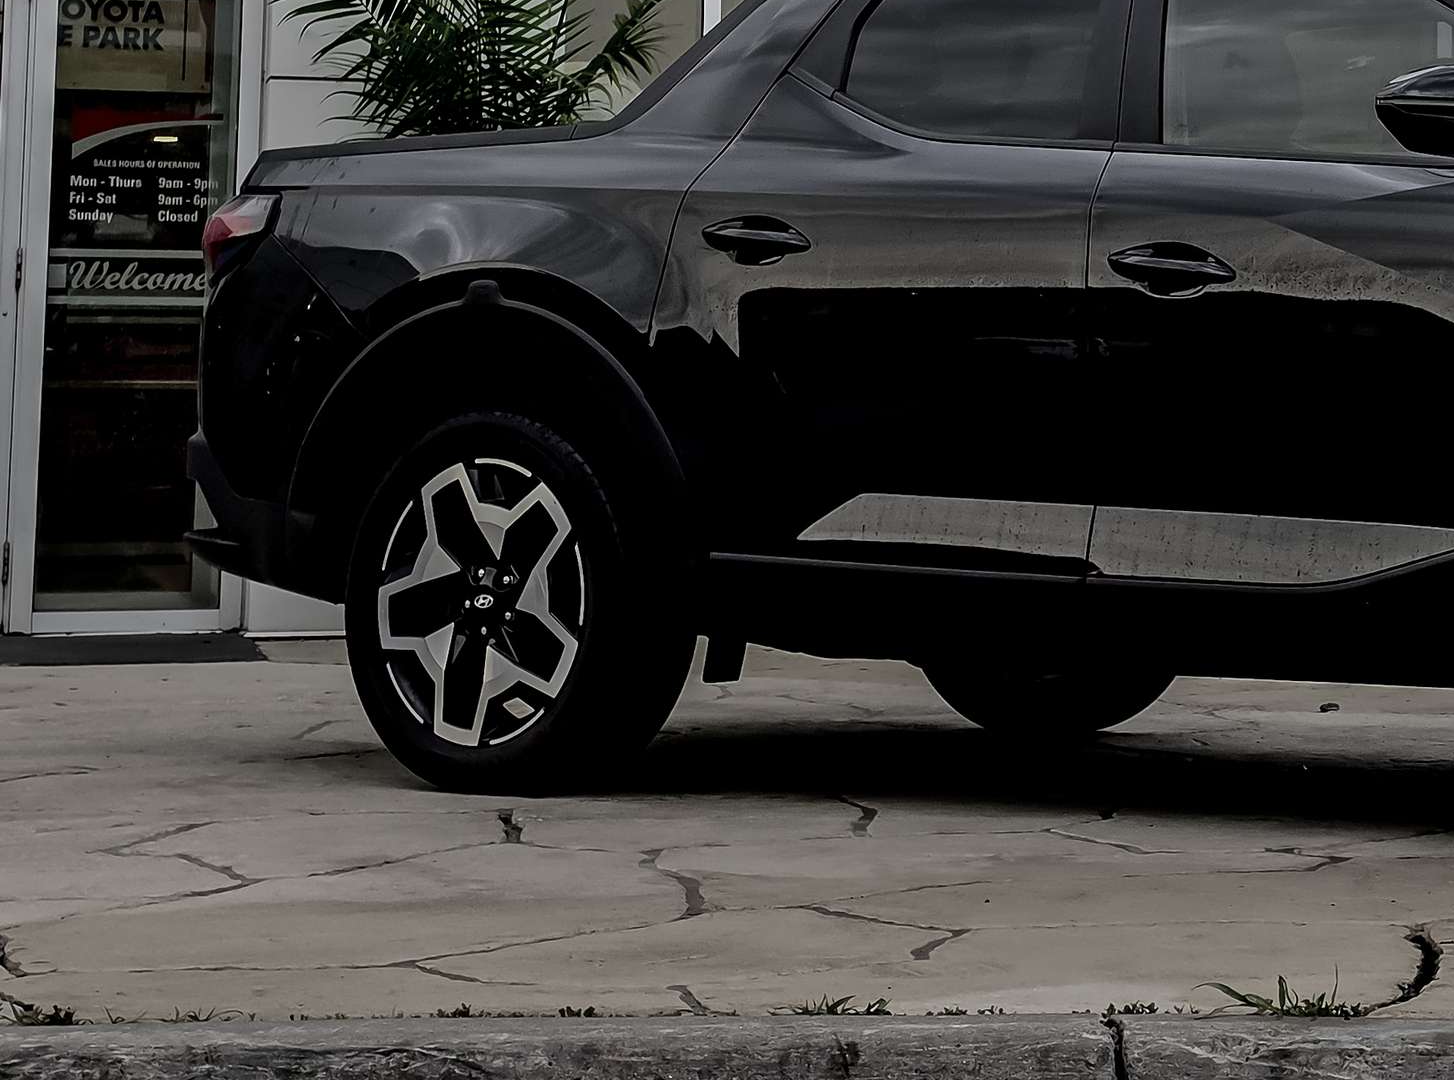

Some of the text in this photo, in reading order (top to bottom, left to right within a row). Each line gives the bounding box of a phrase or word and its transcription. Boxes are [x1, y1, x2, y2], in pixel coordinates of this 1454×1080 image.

[82, 25, 164, 51] PARK
[118, 159, 145, 169] HOURS
[157, 160, 201, 170] OPERATION
[69, 175, 97, 188] Mon
[108, 175, 143, 188] Thurs
[158, 176, 183, 189] 9am
[69, 191, 85, 204] Fri
[96, 192, 117, 205] Sat
[157, 193, 183, 206] 9am
[68, 208, 199, 225] Sunday Closed
[69, 260, 209, 291] Welcome
